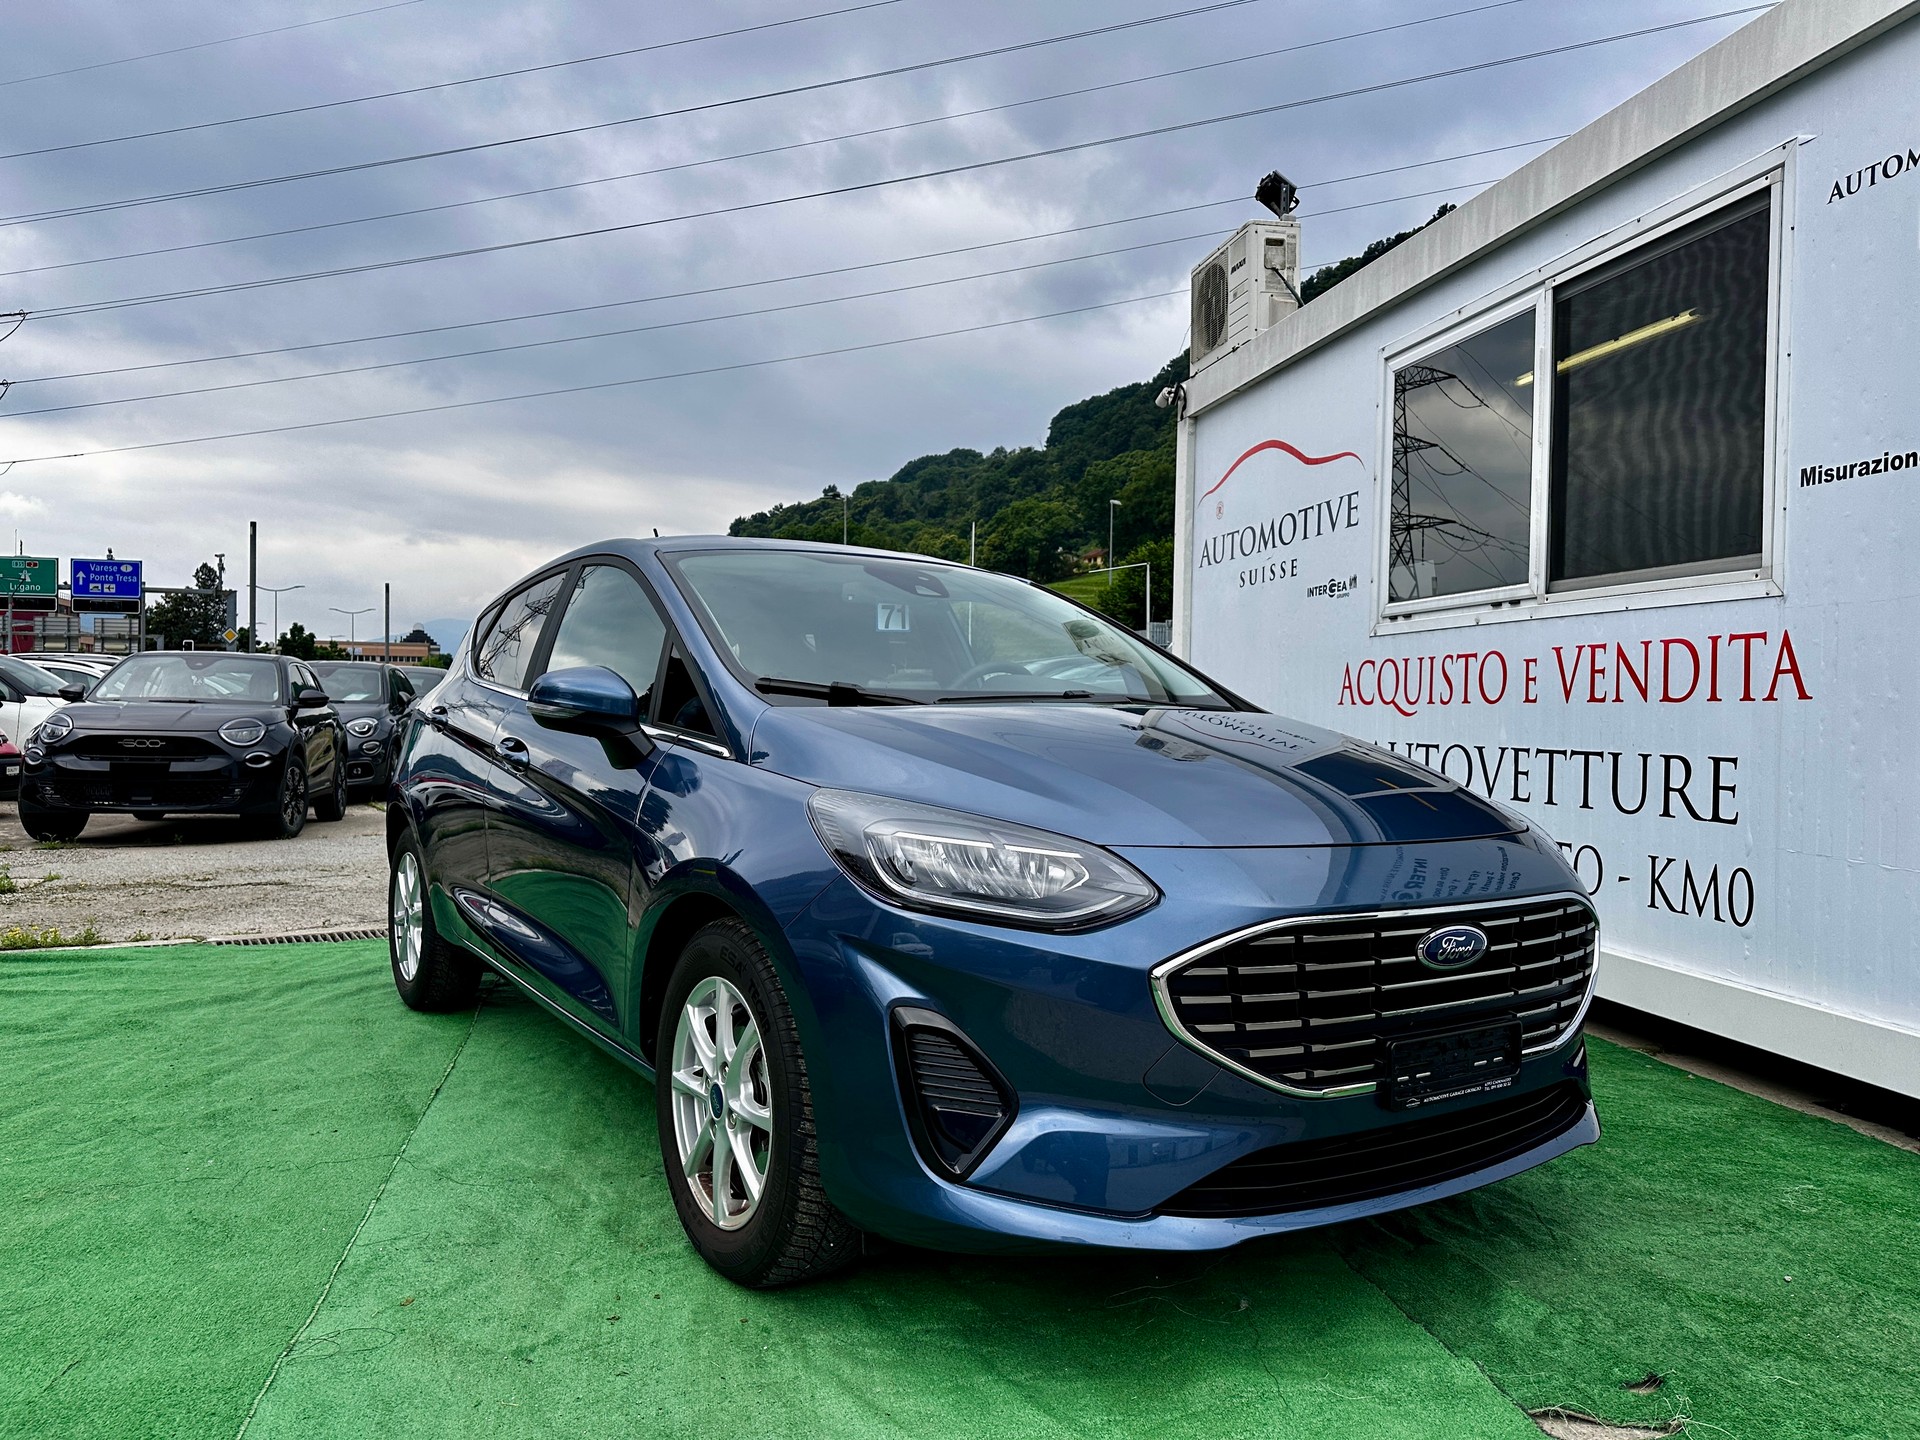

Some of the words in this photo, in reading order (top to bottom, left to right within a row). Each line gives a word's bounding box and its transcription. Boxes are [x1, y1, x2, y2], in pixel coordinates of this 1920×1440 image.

[1800, 451, 1920, 488] Misurazion
[1198, 490, 1360, 568] AUTOMOTIVE
[89, 563, 118, 571] Varese
[115, 574, 137, 582] Tresa
[1239, 558, 1298, 588] SUISSE
[881, 604, 907, 630] 71
[1338, 650, 1508, 717] ACQUISTO
[1522, 658, 1538, 704] E
[1552, 629, 1814, 704] VENDITA
[1437, 935, 1475, 961] Ford
